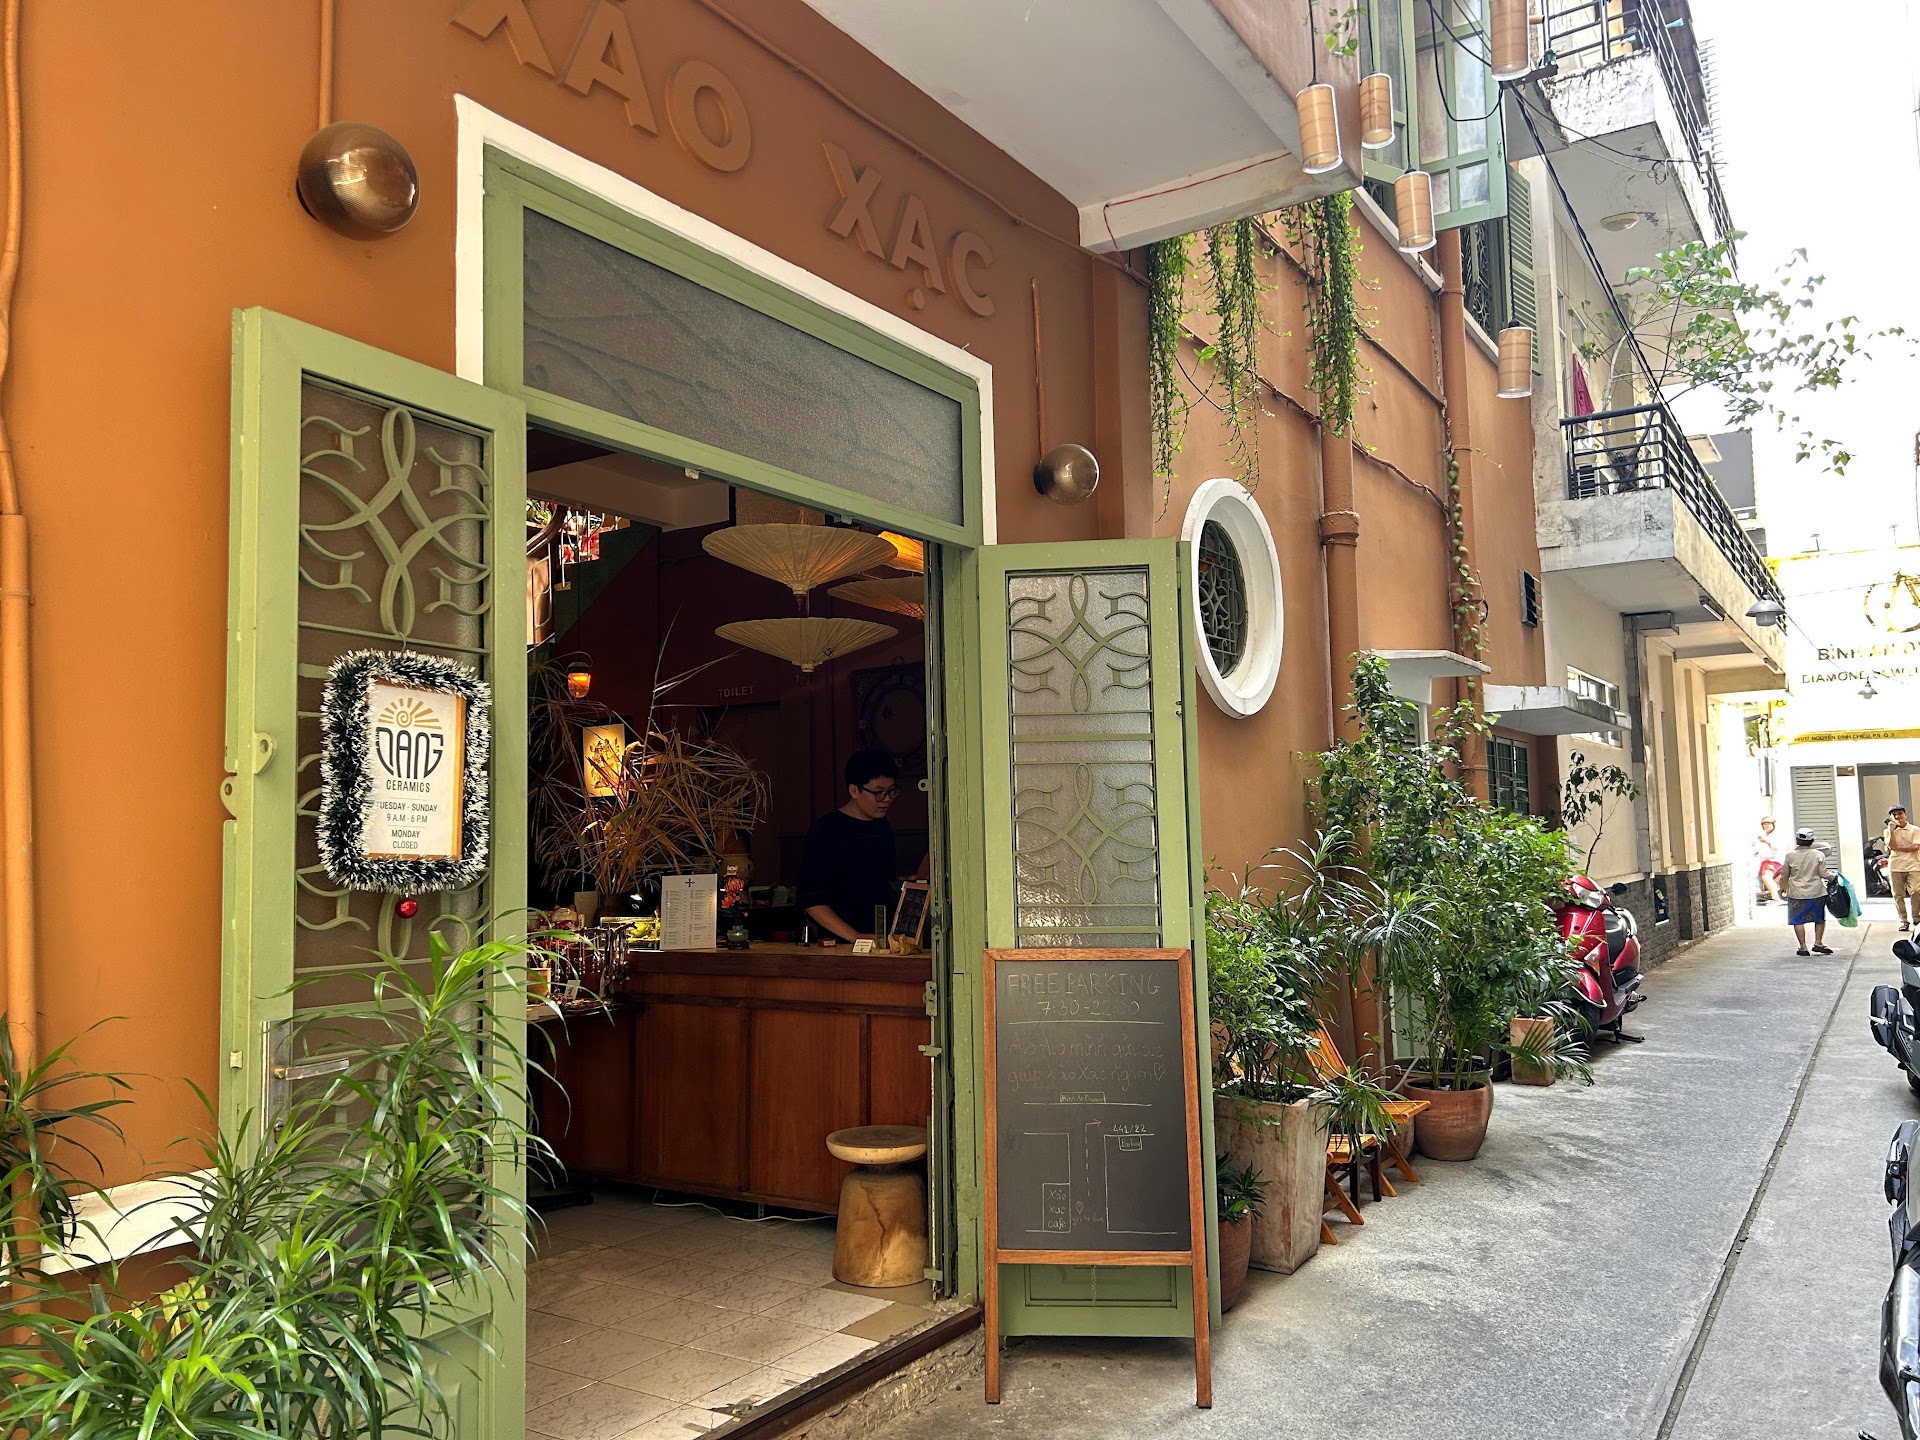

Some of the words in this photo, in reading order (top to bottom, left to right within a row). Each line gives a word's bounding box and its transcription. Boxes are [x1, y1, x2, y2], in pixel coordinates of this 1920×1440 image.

[822, 141, 996, 318] XẠC
[717, 685, 756, 698] TOILET
[386, 779, 431, 794] CERAMICS
[377, 801, 406, 812] UESDAY
[411, 803, 438, 813] SUNDAY
[386, 813, 391, 822] 9
[410, 814, 415, 823] 6
[391, 829, 420, 839] MONDAY
[392, 840, 418, 850] CLOSED
[1007, 973, 1060, 997] FREE
[1066, 972, 1161, 996] PARKING
[1113, 1123, 1147, 1134] 441/22
